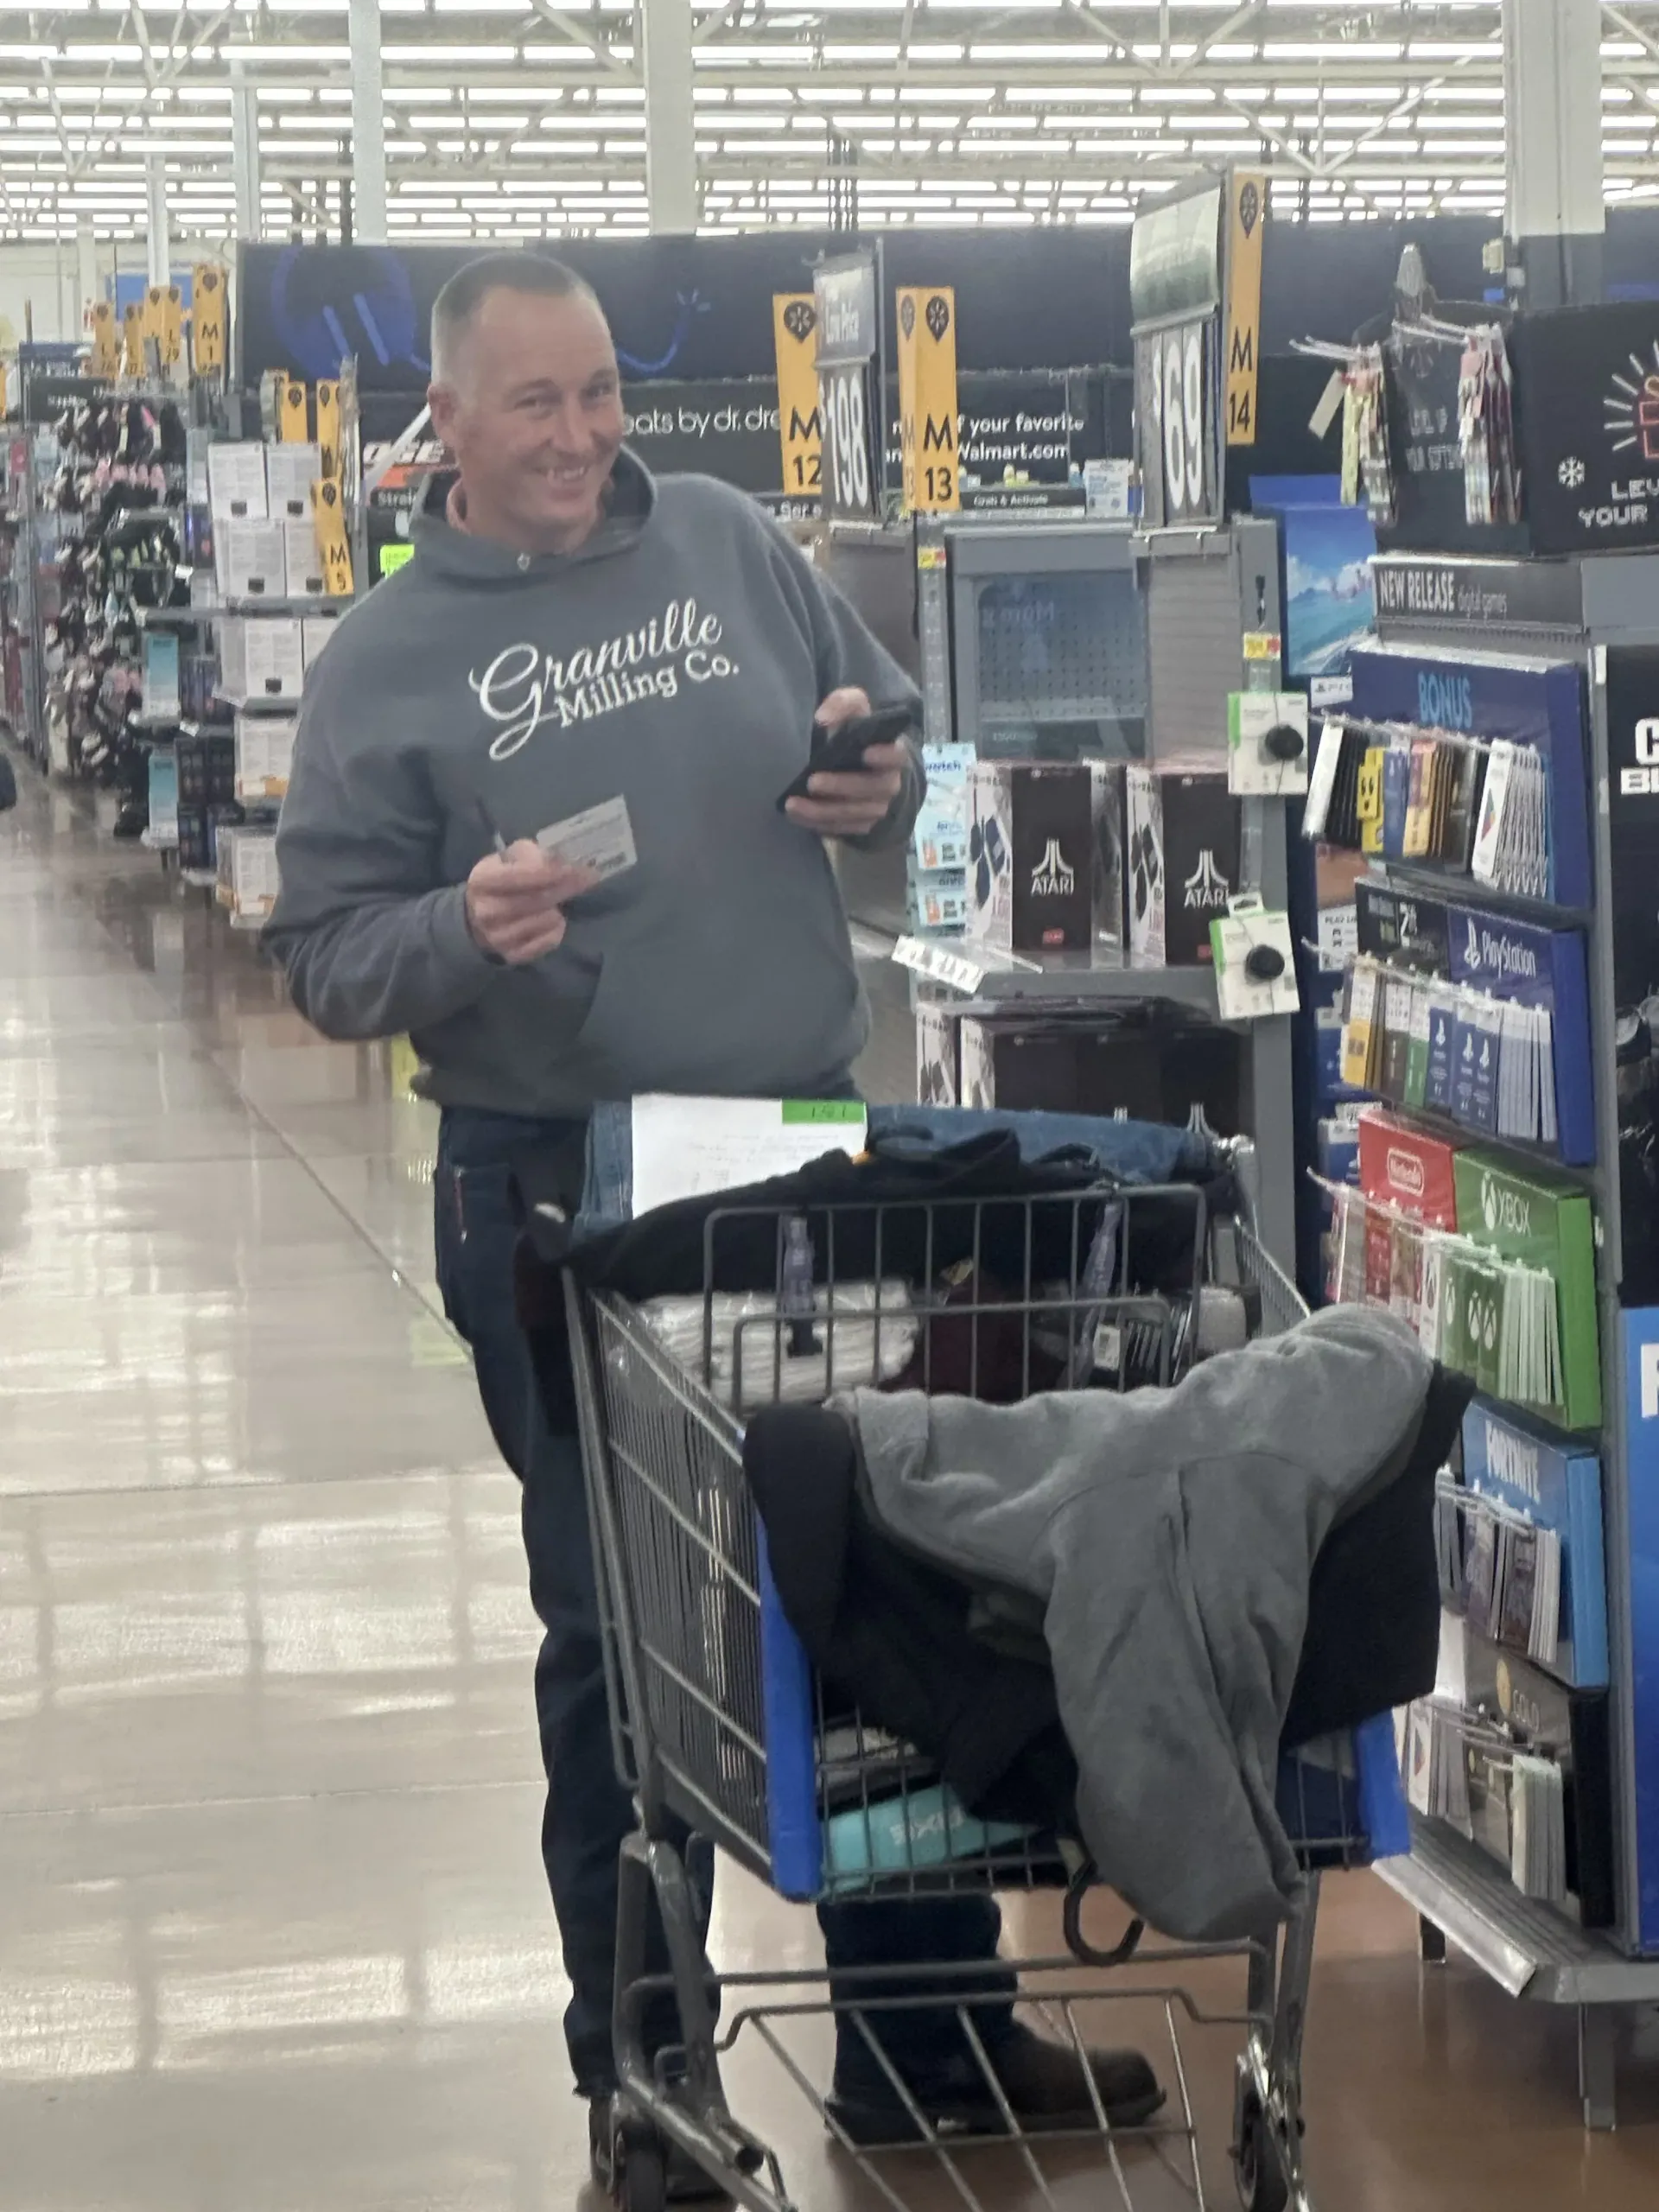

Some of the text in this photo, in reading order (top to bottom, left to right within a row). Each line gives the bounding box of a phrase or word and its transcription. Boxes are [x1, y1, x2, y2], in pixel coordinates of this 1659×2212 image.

[201, 322, 219, 340] M
[1230, 326, 1253, 374] M
[678, 406, 710, 438] by
[788, 405, 821, 442] M
[970, 418, 1010, 440] your
[1015, 411, 1084, 433] favorite
[1152, 334, 1203, 511] $69
[1229, 391, 1250, 434] 14
[923, 413, 953, 453] M
[791, 454, 821, 487] 12
[924, 466, 953, 502] 13
[1578, 504, 1649, 528] YOUR
[330, 544, 346, 564] M
[1379, 570, 1406, 610] NEW
[1407, 570, 1456, 612] RELEASE
[467, 596, 722, 761] Granville
[555, 649, 741, 728] Milling Co.
[1417, 671, 1472, 729] BONUS
[1030, 874, 1075, 897] ATARI
[1184, 887, 1230, 909] ATARI
[1482, 929, 1536, 980] PlayStation
[1497, 1186, 1532, 1238] XBOX
